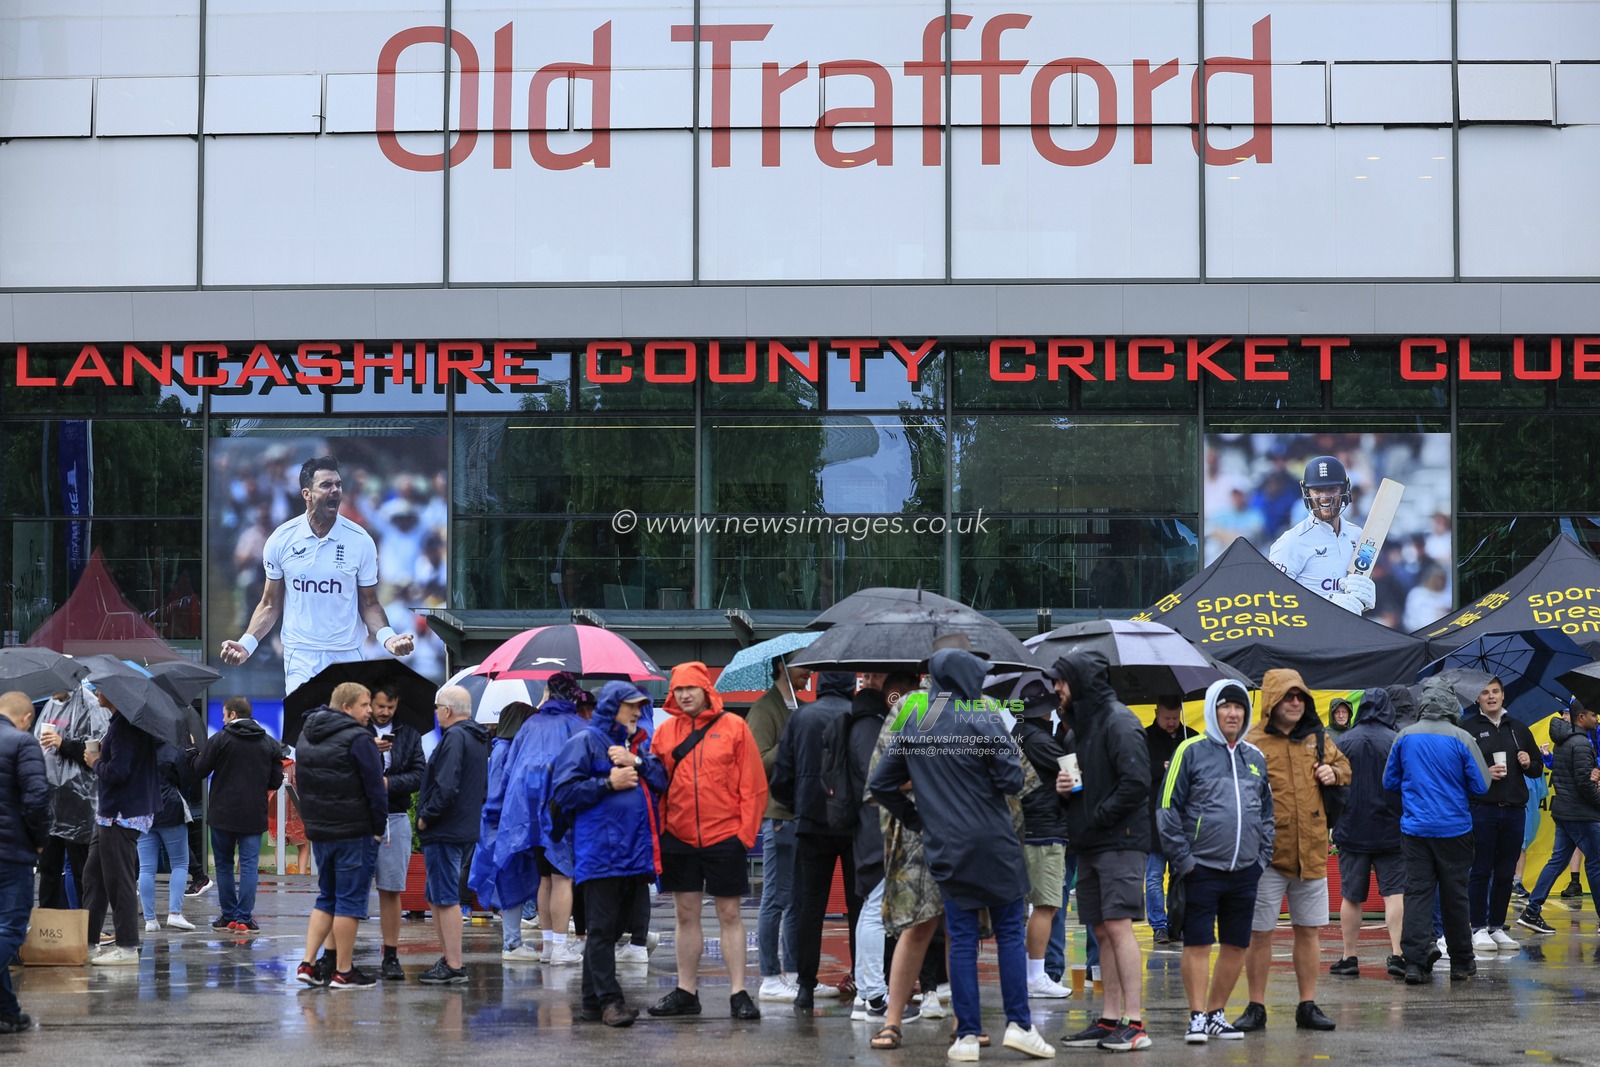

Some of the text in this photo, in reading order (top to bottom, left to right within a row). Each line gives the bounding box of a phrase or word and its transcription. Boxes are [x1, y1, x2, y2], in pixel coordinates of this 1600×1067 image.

[375, 13, 1273, 172] Old Trafford
[16, 341, 538, 387] LANCASHIRE
[586, 339, 938, 384] COUNTY
[989, 338, 1351, 382] CRICKET
[293, 573, 342, 594] cinch
[1197, 590, 1299, 613] sports
[1528, 587, 1600, 607] spor
[1200, 610, 1308, 630] breaks
[1201, 626, 1275, 643] .com
[39, 928, 63, 939] M&S
